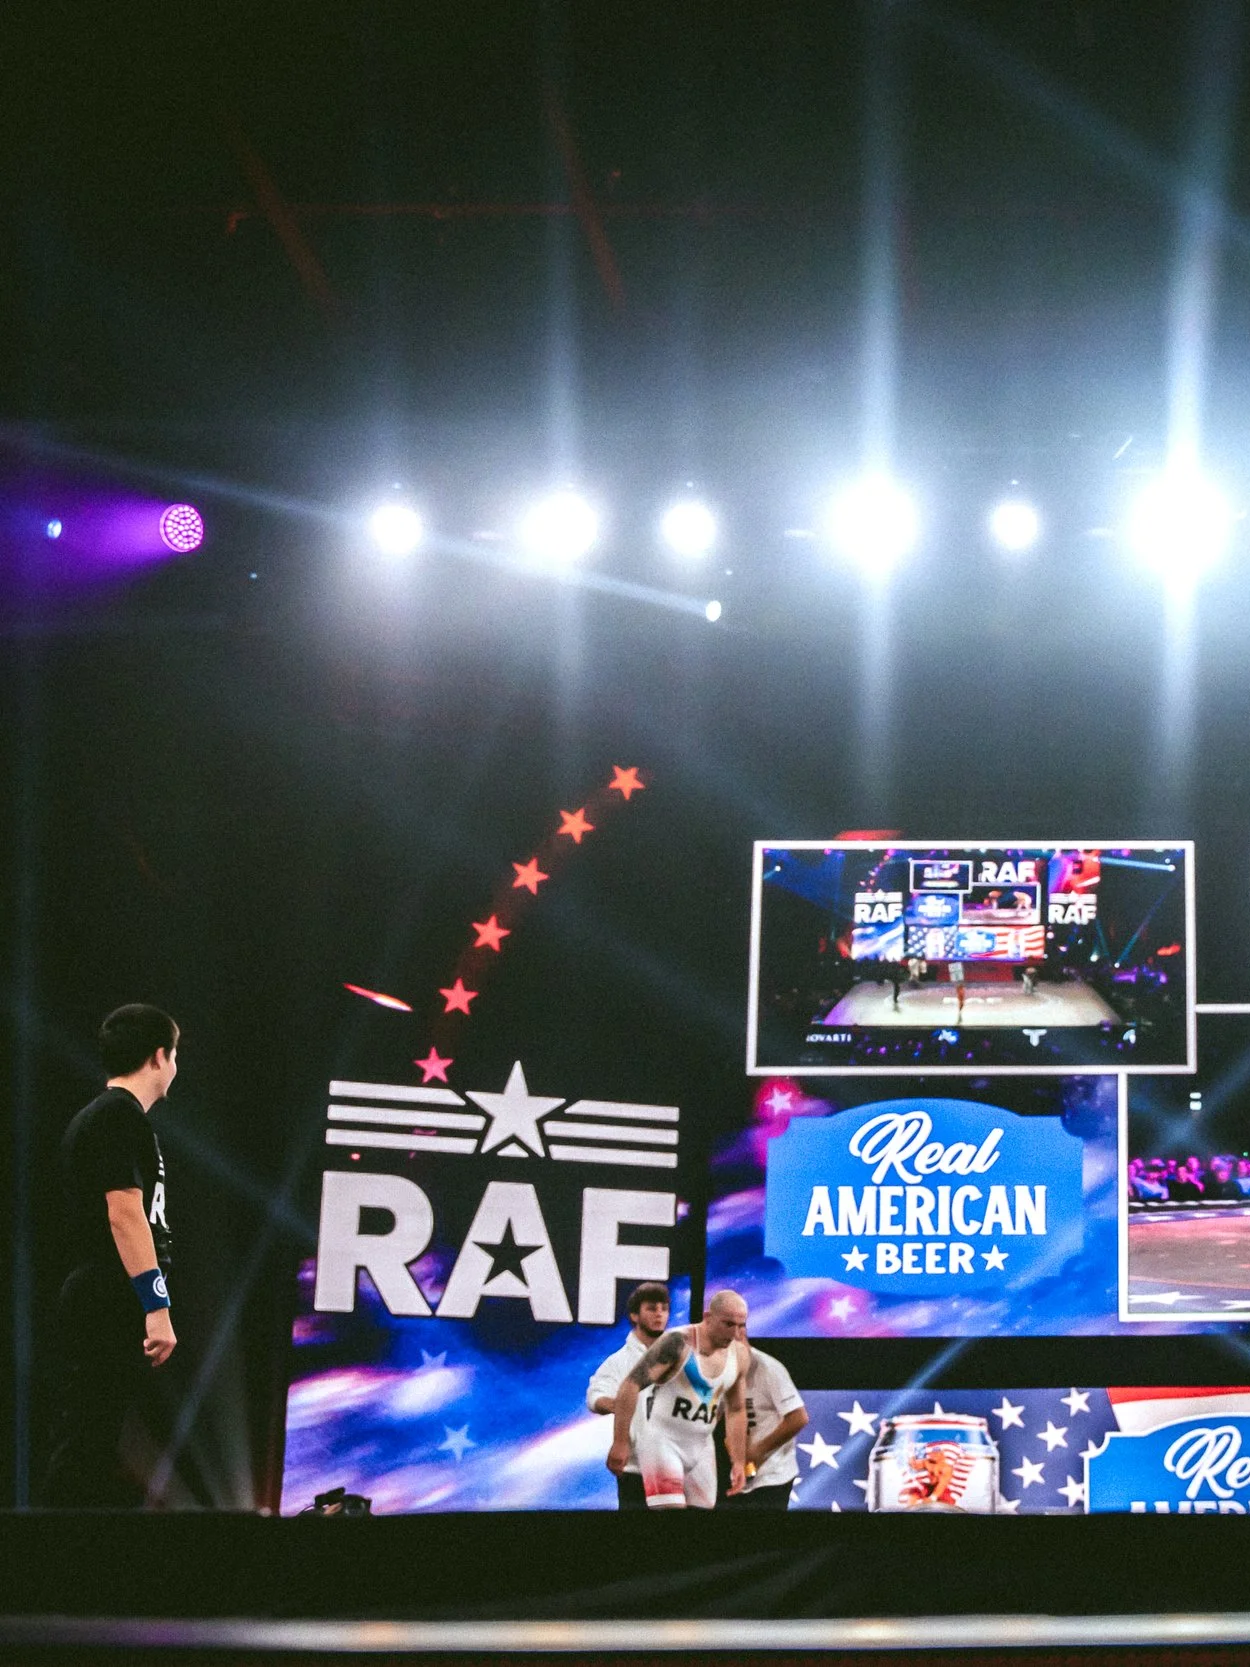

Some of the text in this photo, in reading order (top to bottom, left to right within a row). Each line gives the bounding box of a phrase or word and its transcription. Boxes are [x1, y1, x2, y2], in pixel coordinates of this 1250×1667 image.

[981, 861, 1035, 882] RAF
[854, 904, 903, 923] RAF
[1048, 904, 1097, 924] RAF
[849, 1110, 1004, 1184] Real
[802, 1184, 1047, 1236] AMERICAN
[313, 1170, 677, 1325] RAF
[876, 1242, 975, 1275] BEER
